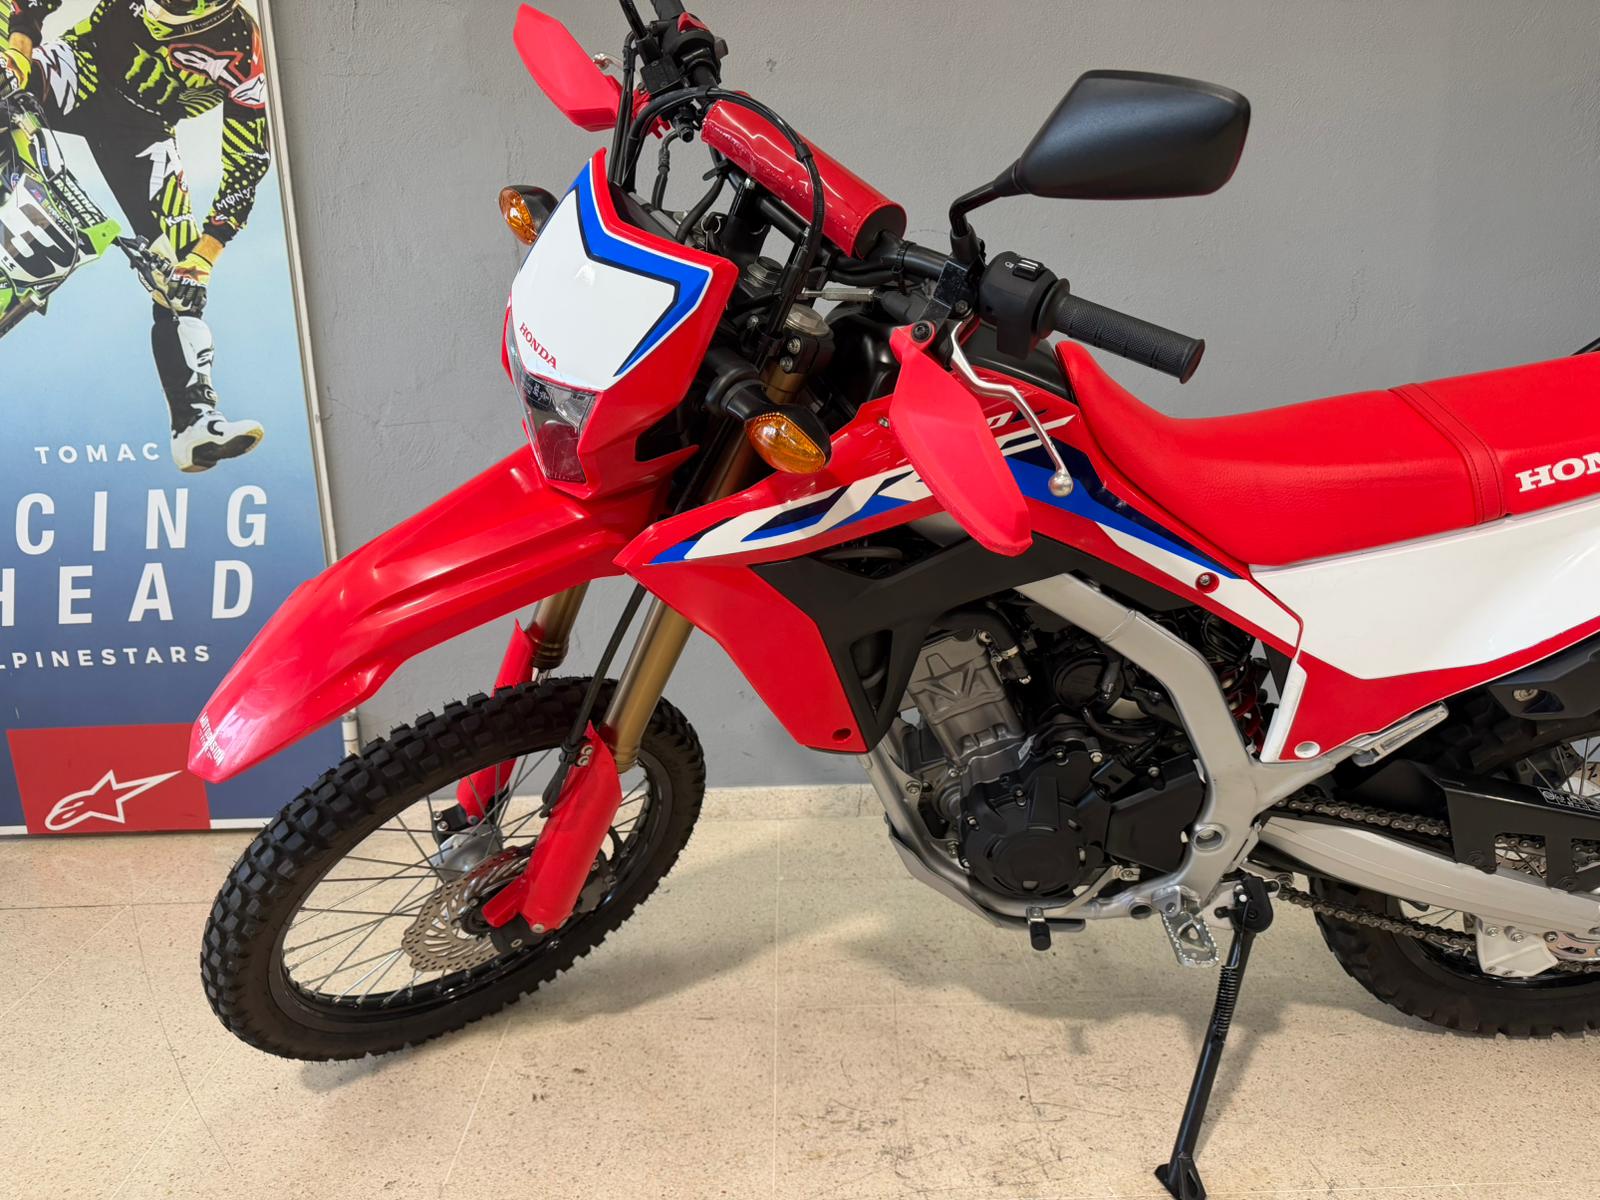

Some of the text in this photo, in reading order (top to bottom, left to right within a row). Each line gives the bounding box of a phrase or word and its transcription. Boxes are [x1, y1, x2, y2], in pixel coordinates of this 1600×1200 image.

[519, 322, 557, 370] HONDA
[35, 442, 160, 464] TOMAC
[15, 485, 268, 555] CING
